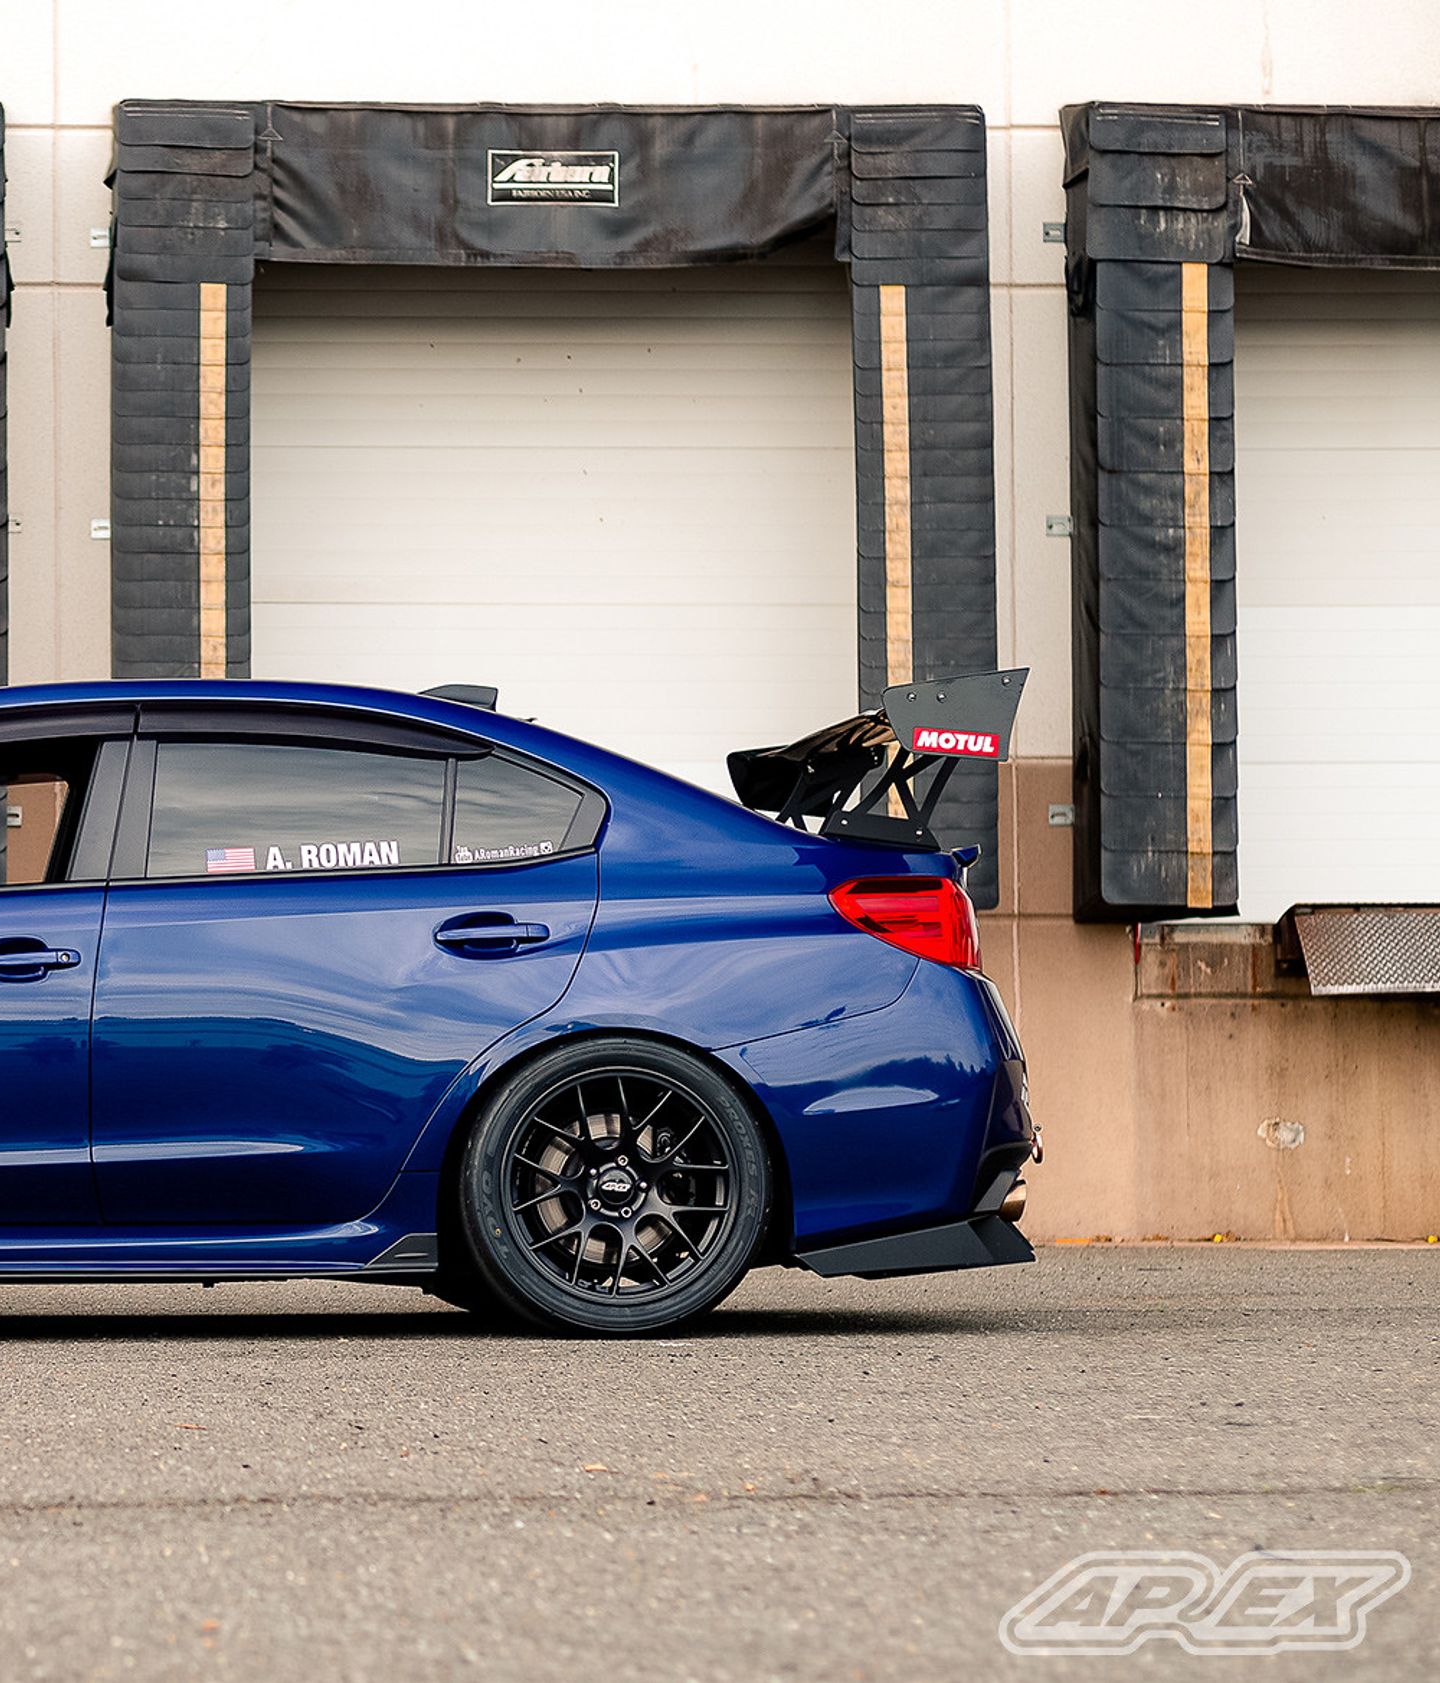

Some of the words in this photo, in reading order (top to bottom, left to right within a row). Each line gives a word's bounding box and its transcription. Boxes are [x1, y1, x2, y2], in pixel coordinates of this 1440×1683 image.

[917, 731, 994, 752] MOTUL
[266, 847, 292, 870] A.
[300, 841, 399, 868] ROMAN
[474, 844, 540, 861] ARomanRacing
